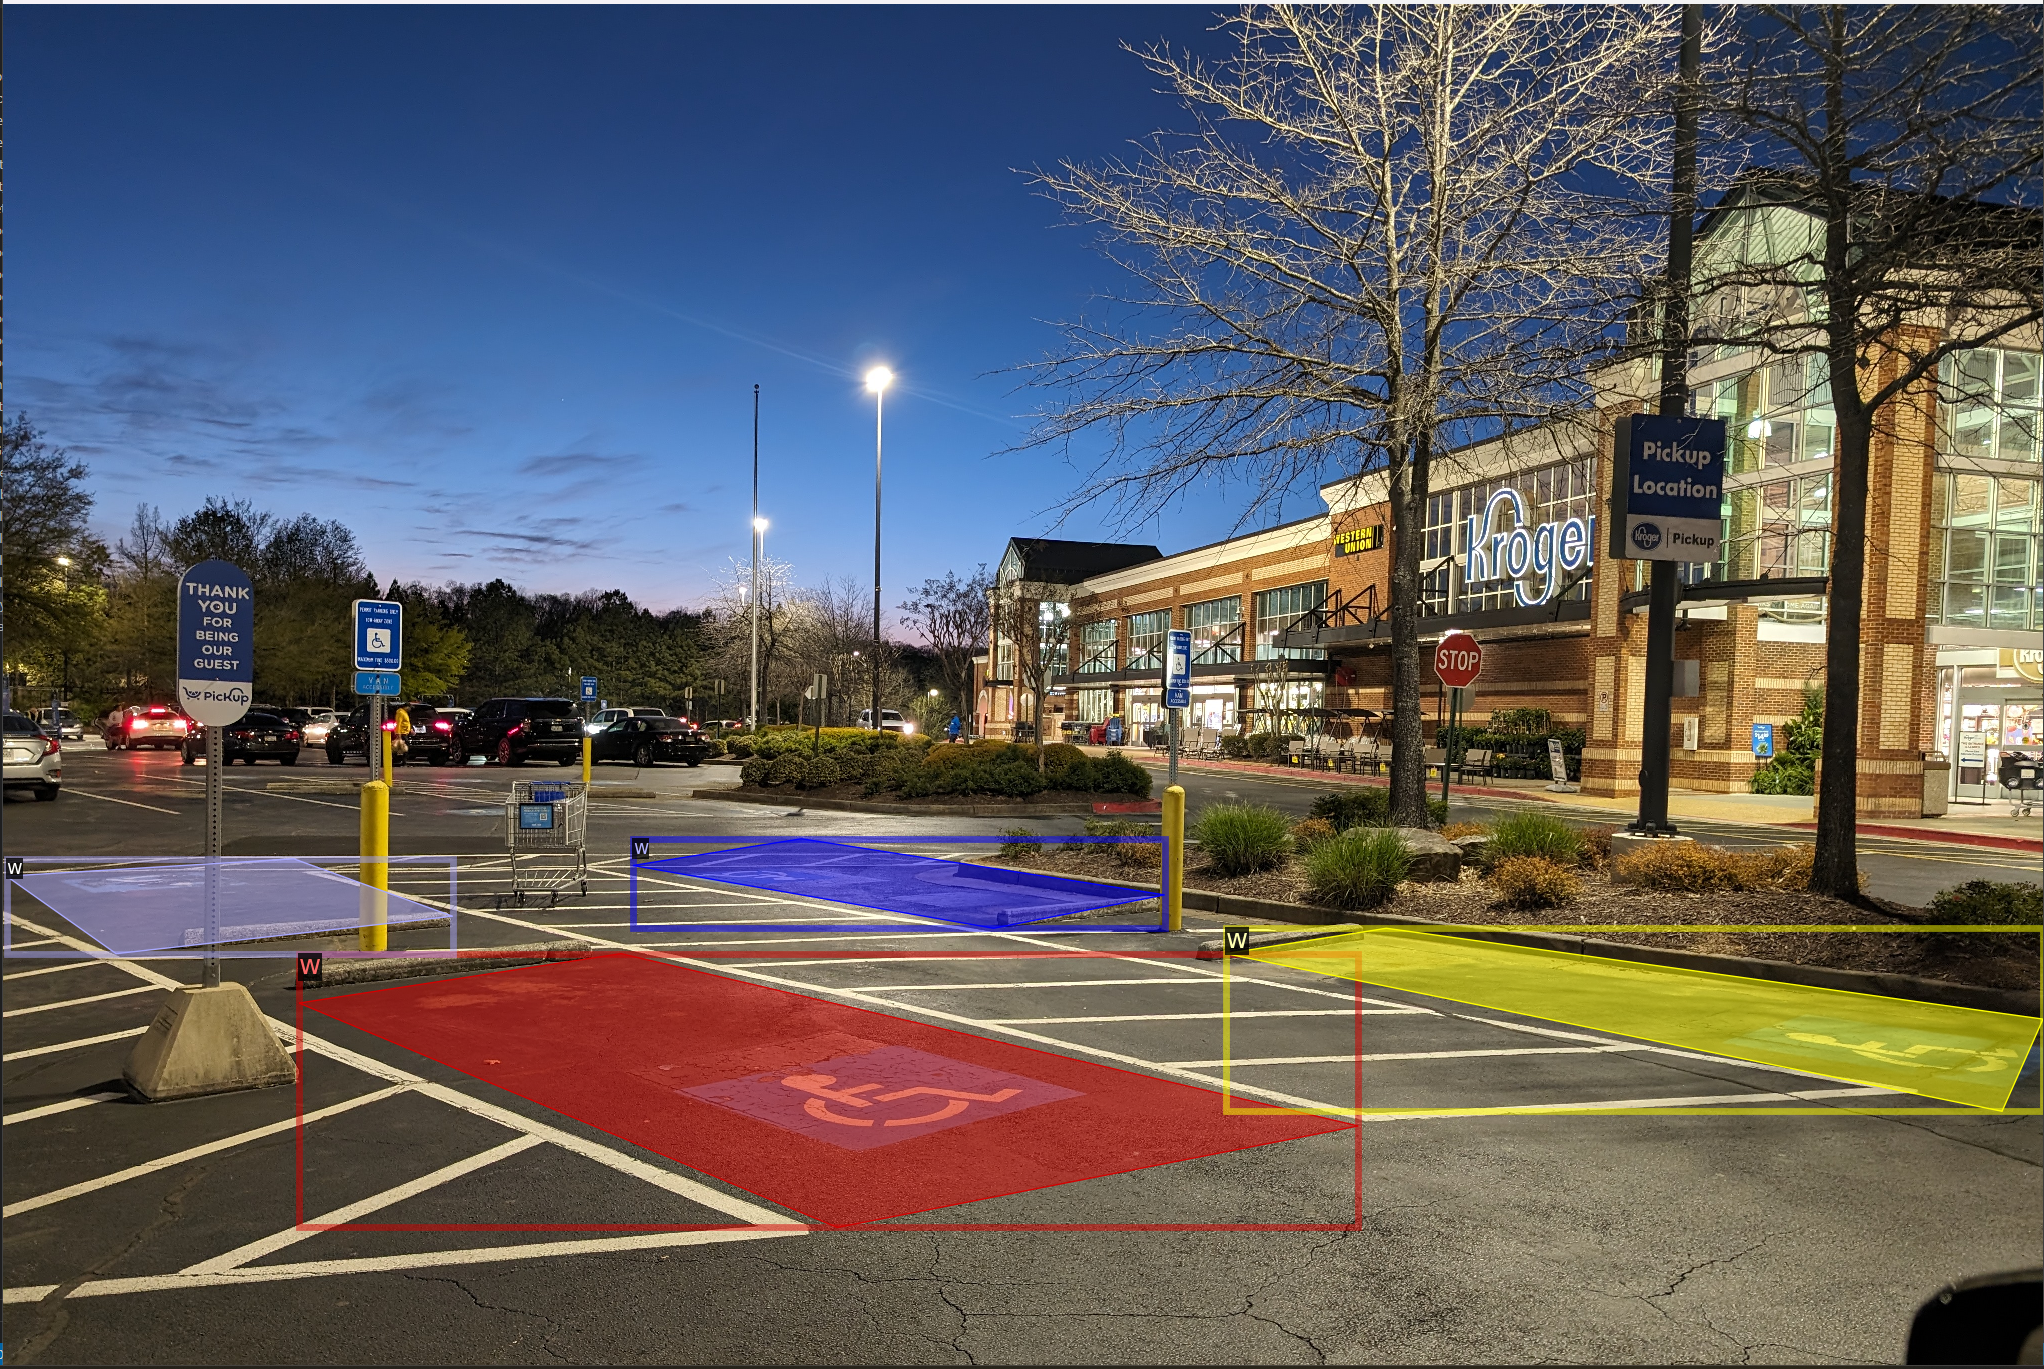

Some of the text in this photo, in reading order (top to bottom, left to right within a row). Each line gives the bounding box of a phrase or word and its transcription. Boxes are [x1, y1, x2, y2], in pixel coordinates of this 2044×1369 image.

[1643, 441, 1711, 469] Pickup
[1633, 474, 1717, 499] Location
[1344, 537, 1372, 554] UNION
[1635, 527, 1714, 549] Kroger Pickup
[186, 583, 249, 600] THANK
[198, 600, 237, 615] YOU
[203, 617, 232, 628] FOR
[196, 631, 239, 642] BEING
[202, 645, 232, 656] OUR
[194, 659, 239, 670] GUEST
[1438, 649, 1479, 671] STOP
